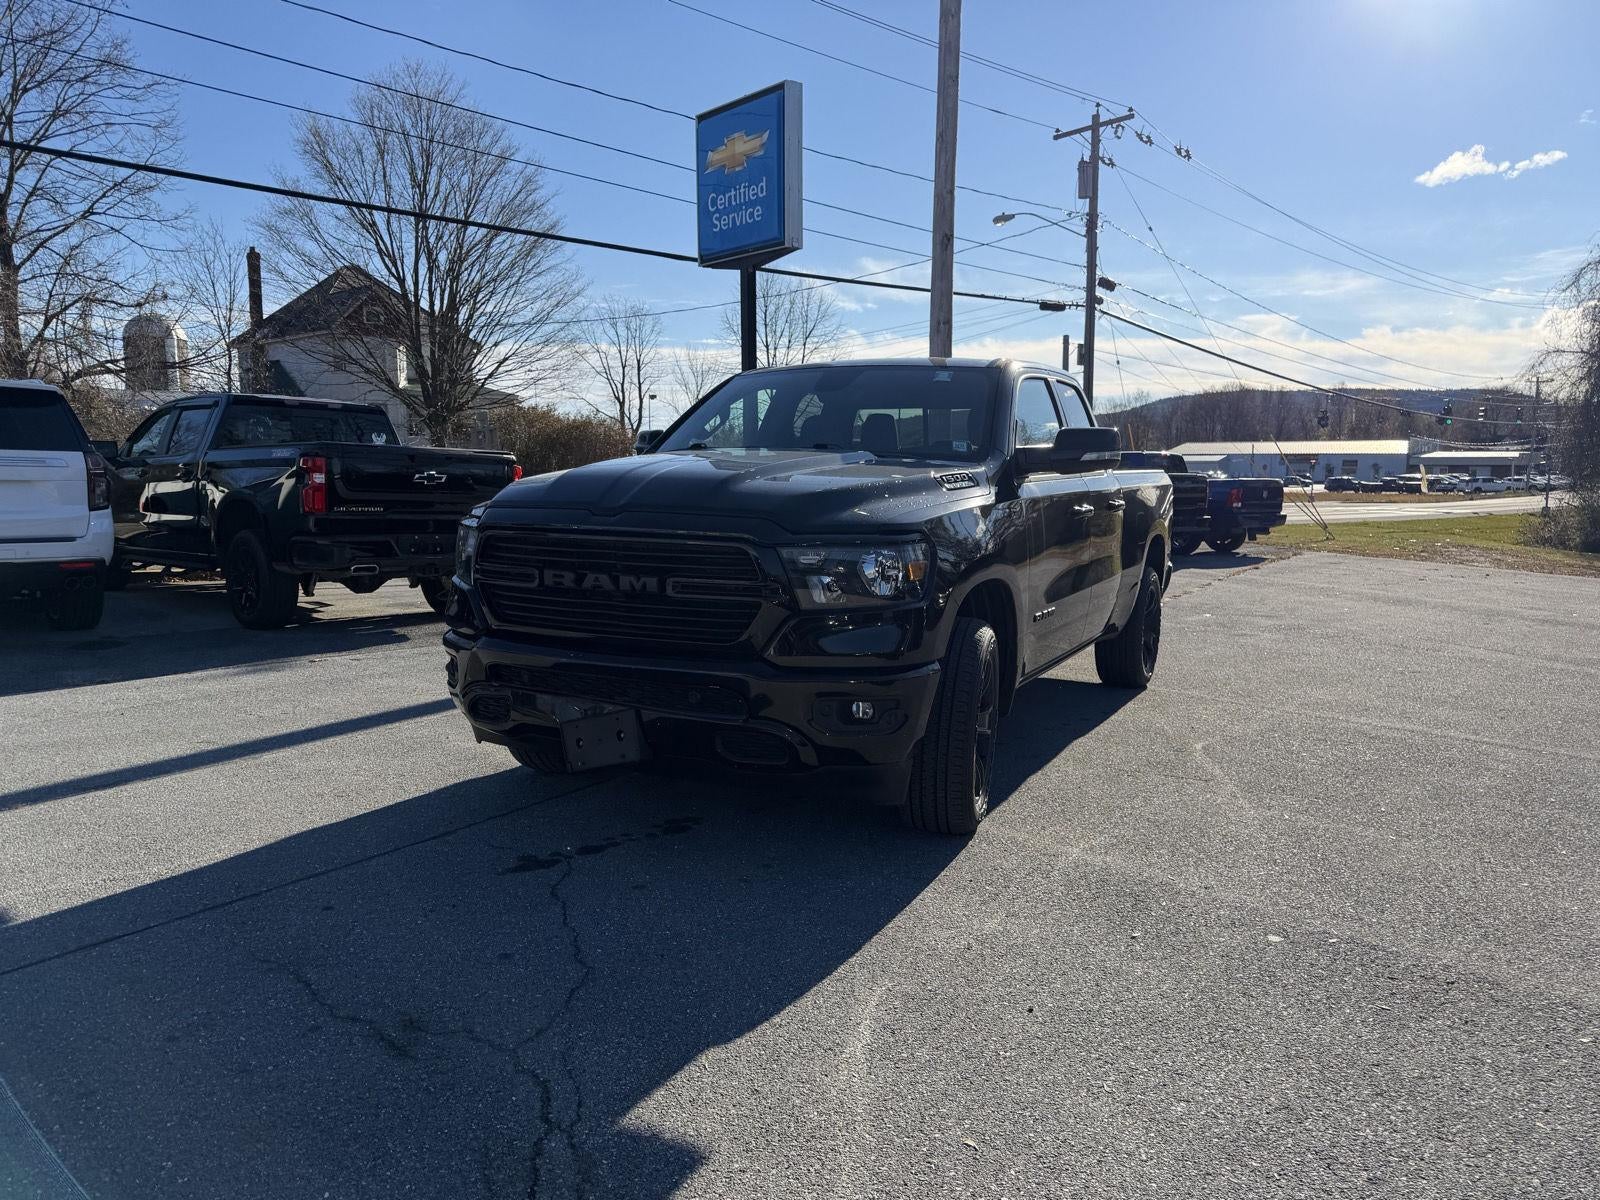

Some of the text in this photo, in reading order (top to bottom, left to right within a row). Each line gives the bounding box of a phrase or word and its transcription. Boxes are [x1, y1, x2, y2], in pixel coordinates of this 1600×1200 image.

[708, 176, 767, 212] Certified
[712, 206, 762, 232] Service
[942, 473, 969, 483] 1500
[543, 569, 659, 593] RAM
